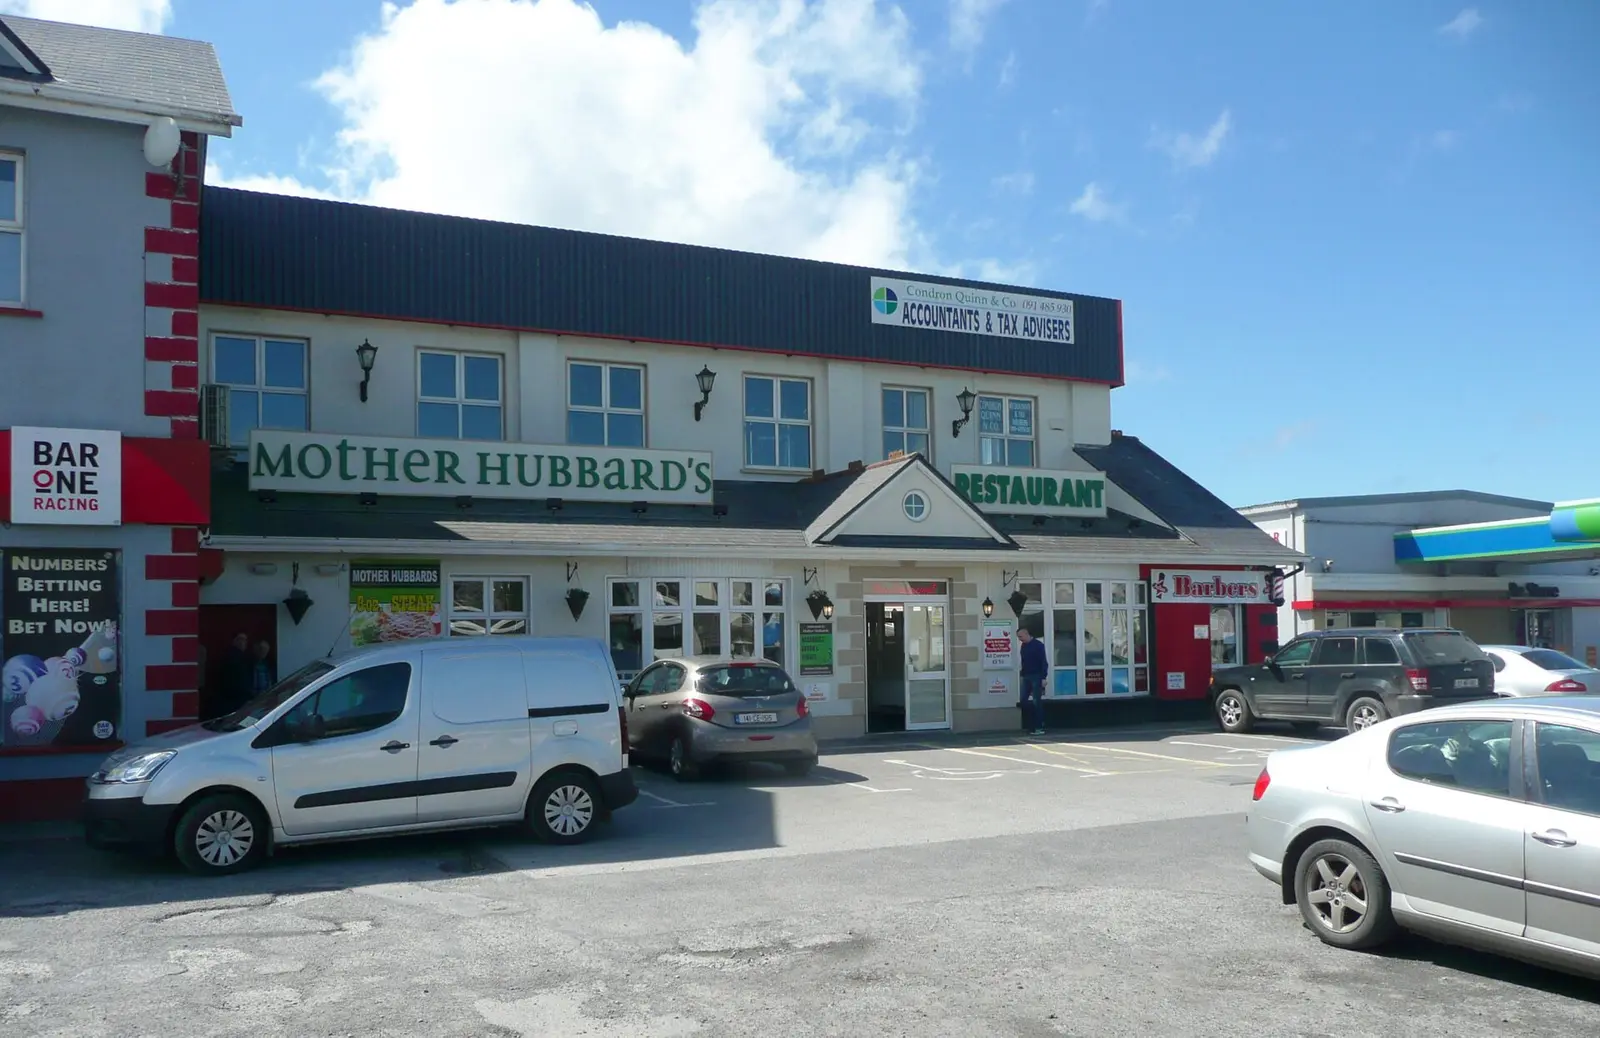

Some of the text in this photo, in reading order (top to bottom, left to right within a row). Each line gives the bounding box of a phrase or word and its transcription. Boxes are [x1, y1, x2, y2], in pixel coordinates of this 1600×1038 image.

[907, 285, 952, 300] Condron
[955, 291, 988, 304] Quinn
[991, 295, 1000, 307] &
[902, 301, 1071, 341] ACCOUNTANTS & TAX ADVISERS
[33, 440, 100, 468] BAR
[33, 469, 99, 495] ONE
[954, 472, 1105, 508] RESTAURANT
[33, 497, 99, 511] RACING
[352, 569, 438, 583] MOTHER HUBBARDS
[1172, 574, 1259, 598] Barbers
[391, 594, 434, 612] STEAK
